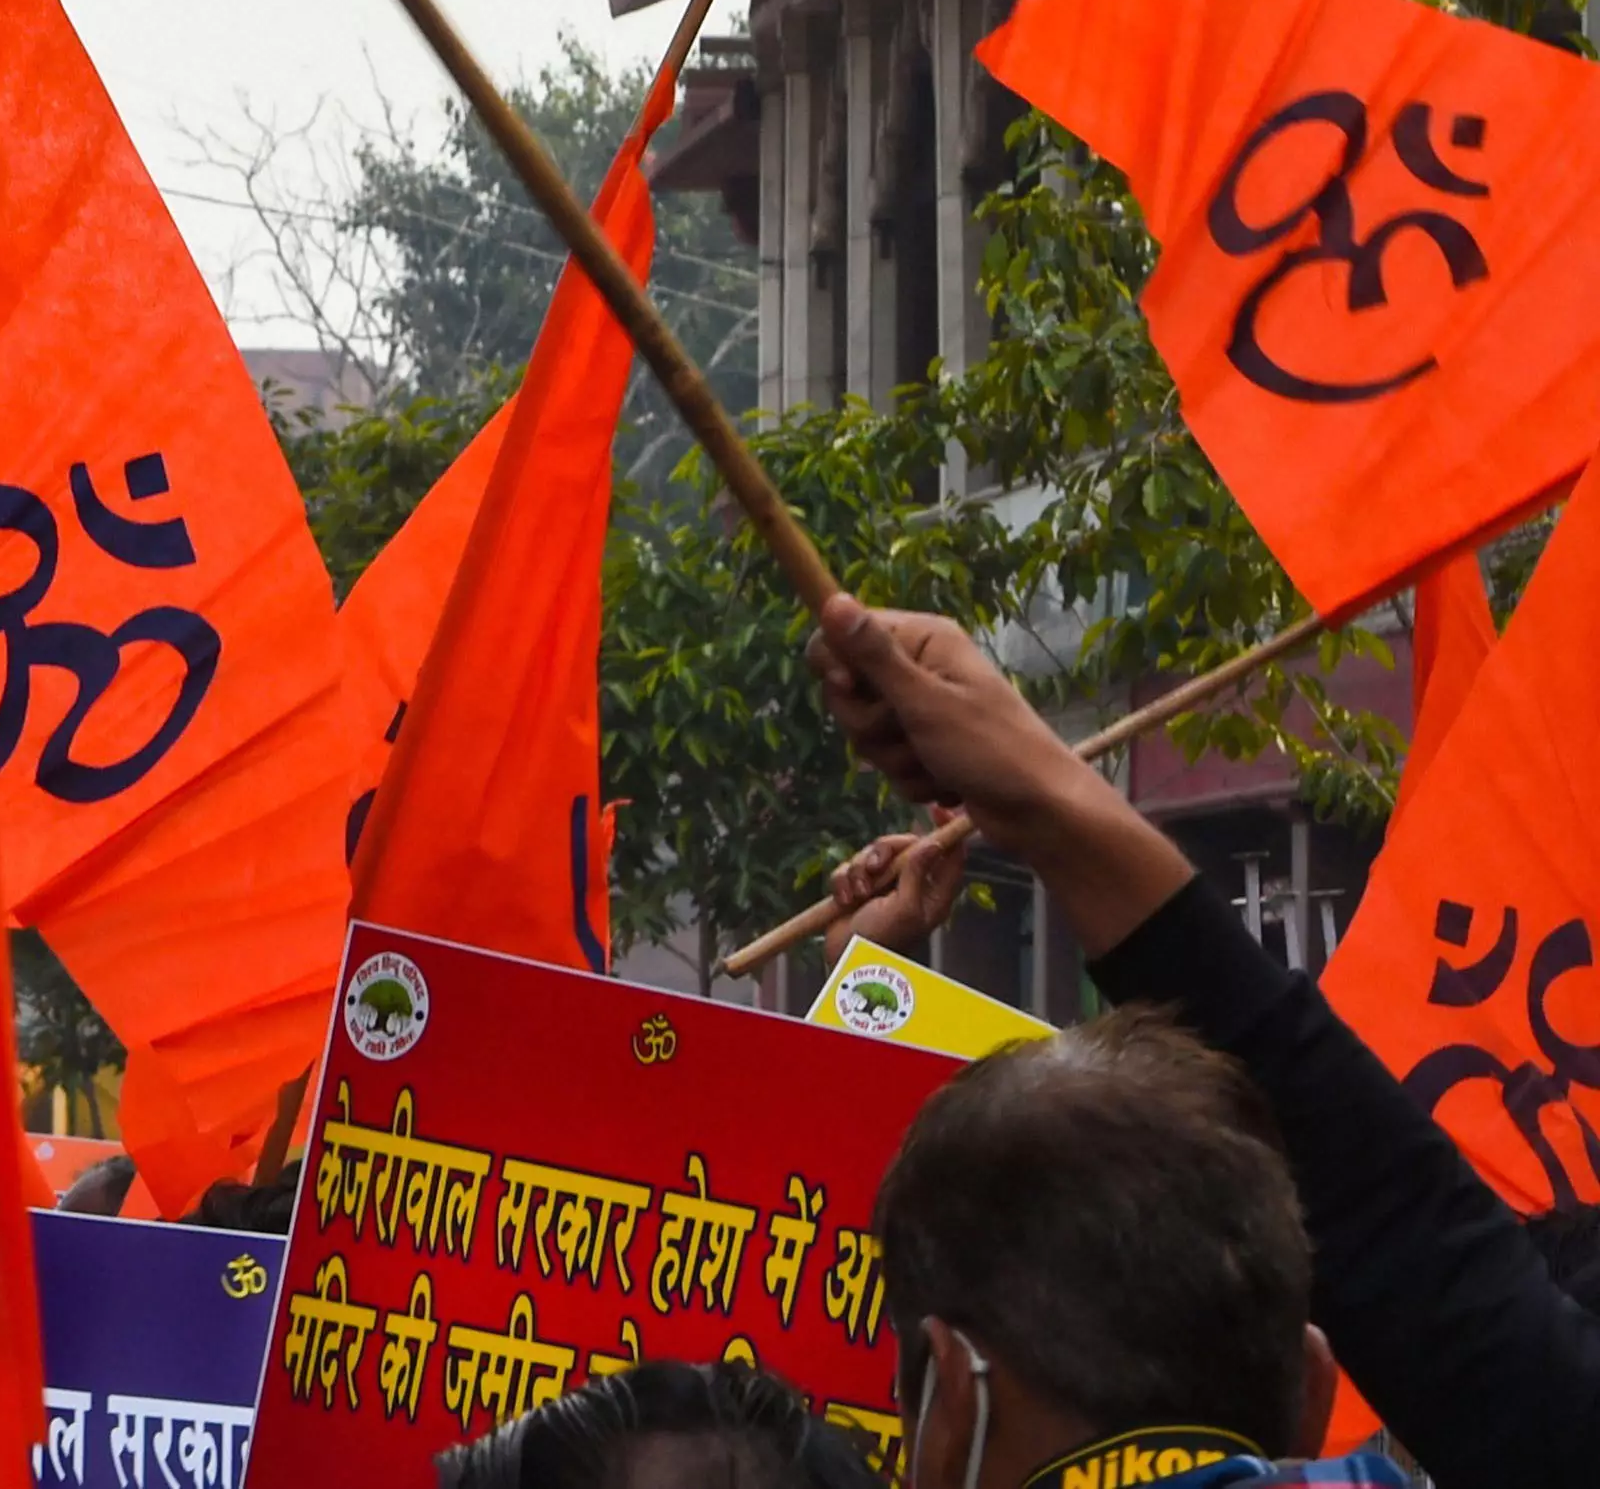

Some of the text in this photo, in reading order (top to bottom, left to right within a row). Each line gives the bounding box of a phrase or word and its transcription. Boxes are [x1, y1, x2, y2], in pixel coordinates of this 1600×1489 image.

[316, 1080, 491, 1260] केजरीवाल
[497, 1158, 652, 1294] सरकार
[651, 1154, 756, 1313] होश
[765, 1175, 824, 1327] में
[285, 1255, 377, 1411] मंदिर
[380, 1273, 438, 1423] की
[107, 1394, 256, 1489] सरका
